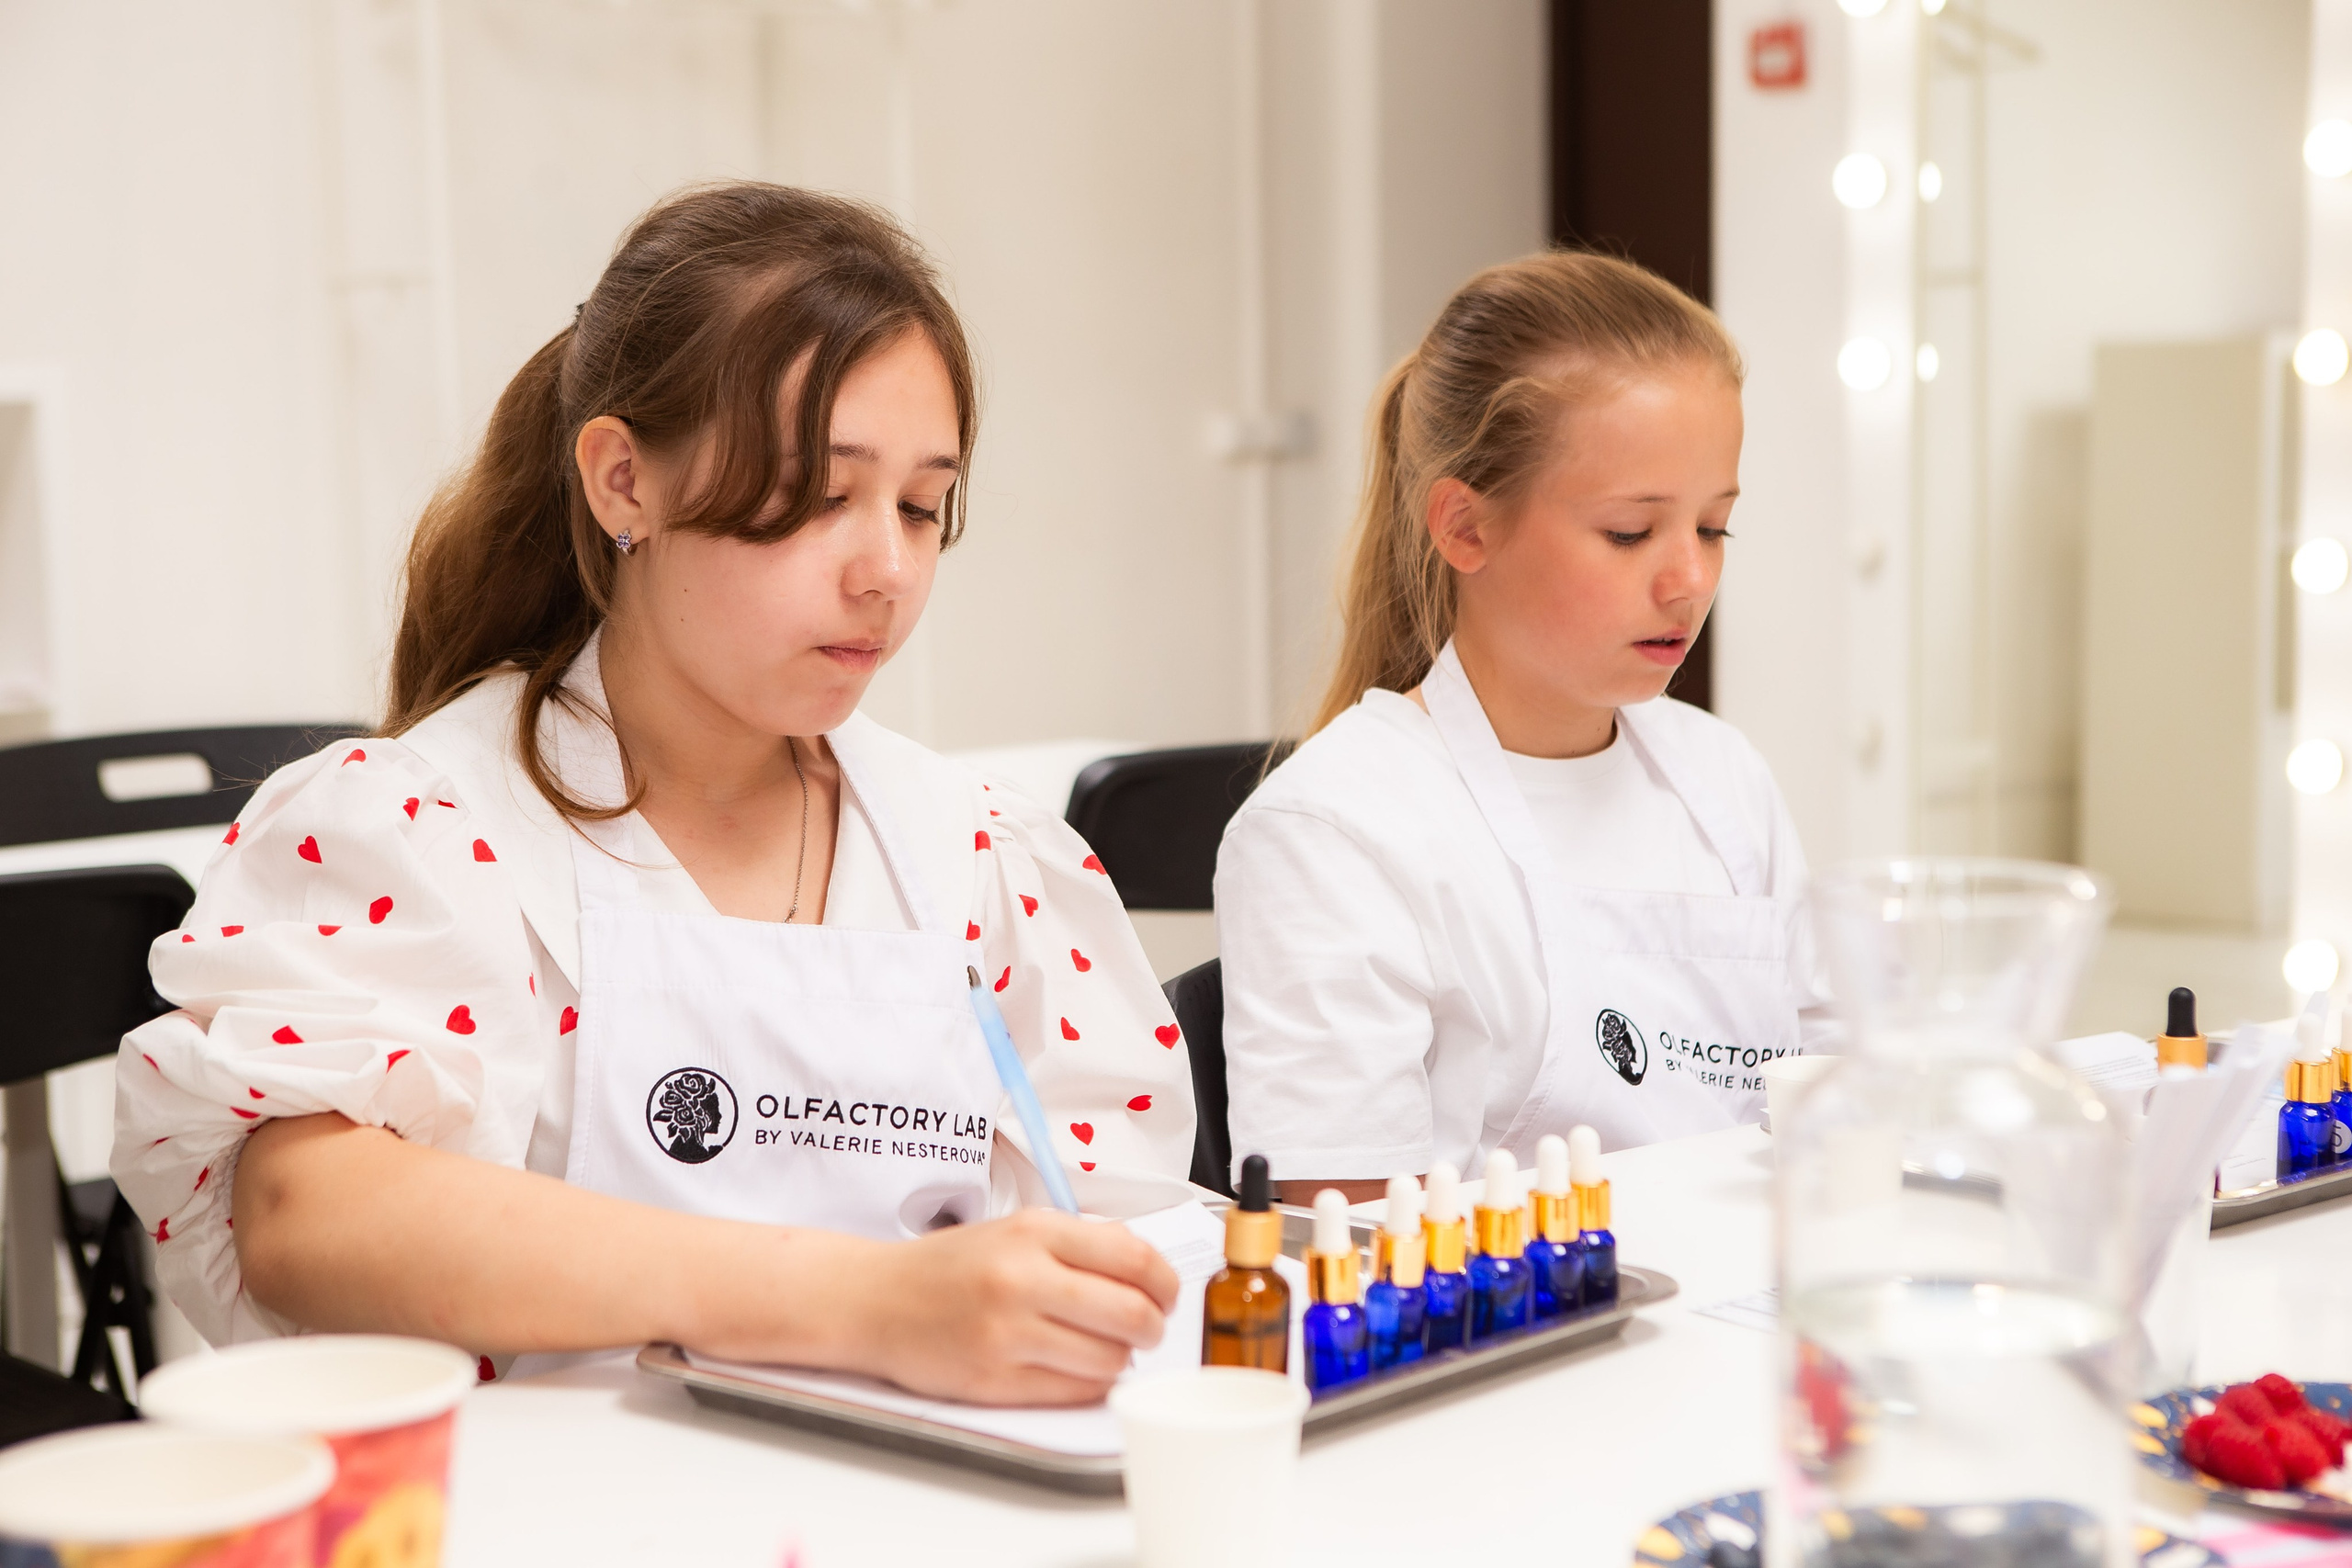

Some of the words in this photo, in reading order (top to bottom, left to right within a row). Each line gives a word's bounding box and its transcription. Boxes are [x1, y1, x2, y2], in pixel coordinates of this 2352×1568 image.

[756, 1094, 947, 1133] OLFACTORY
[954, 1113, 987, 1141] LAB
[755, 1129, 781, 1145] BY
[791, 1131, 883, 1155] VALERIE
